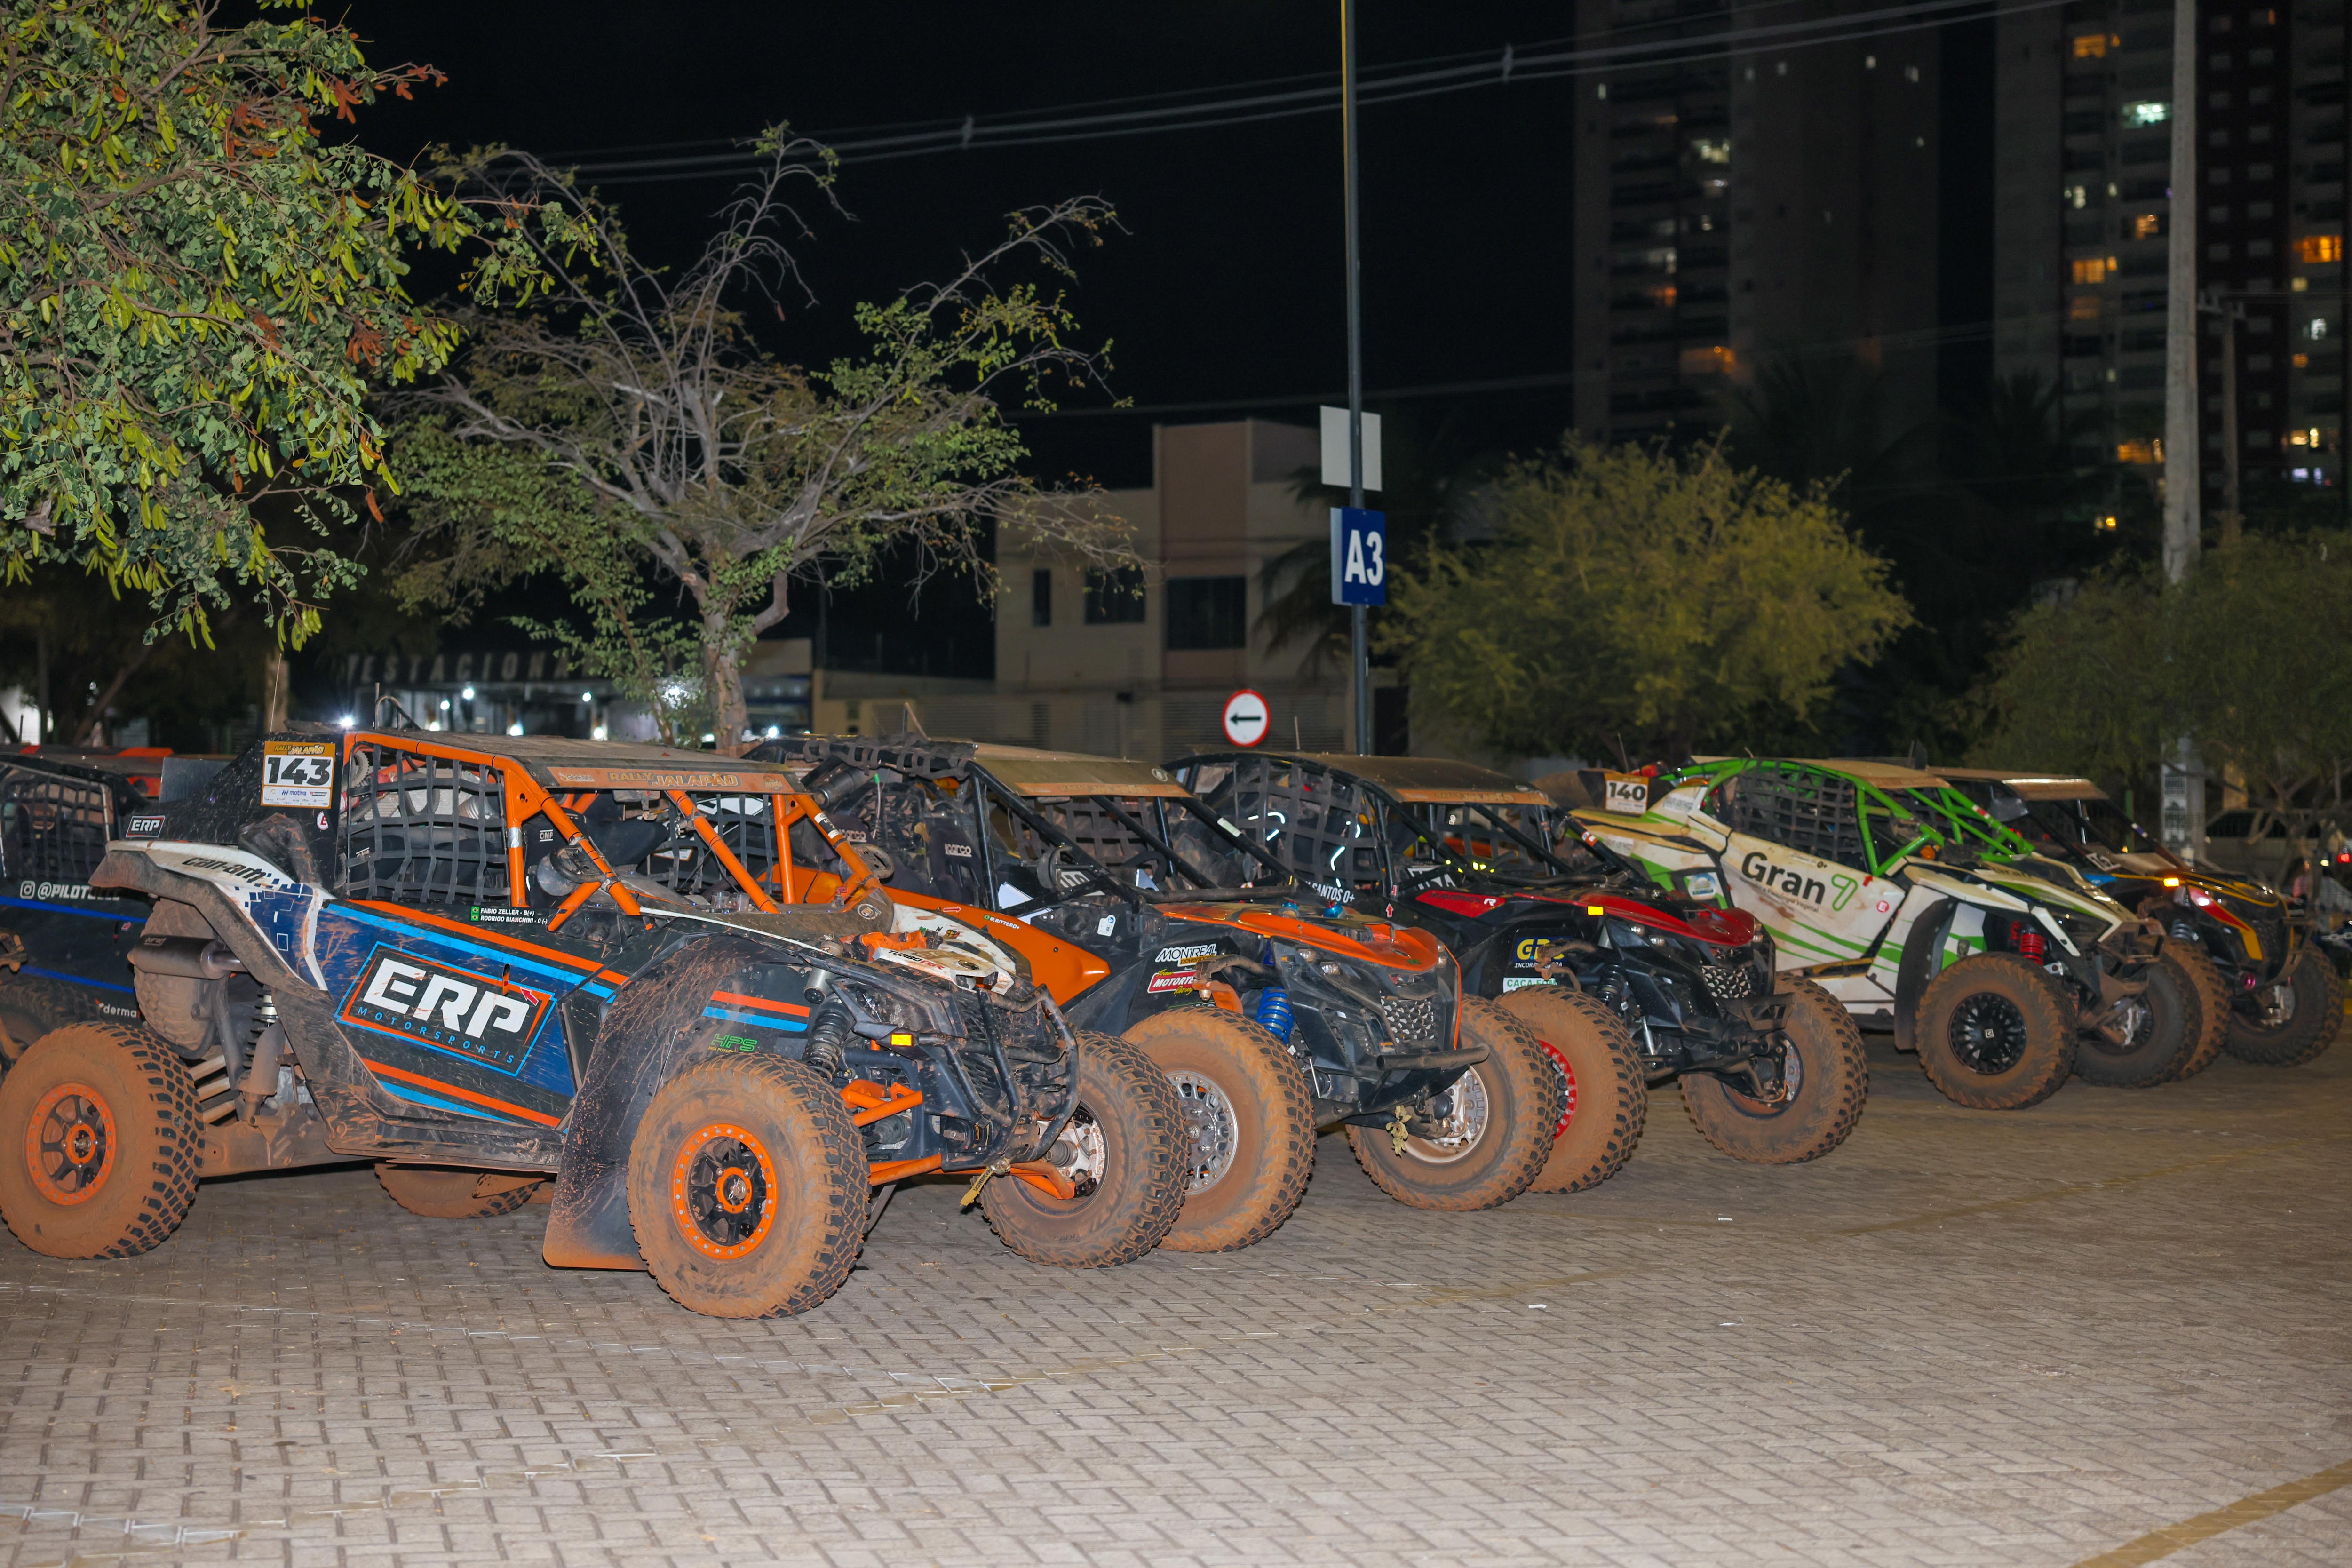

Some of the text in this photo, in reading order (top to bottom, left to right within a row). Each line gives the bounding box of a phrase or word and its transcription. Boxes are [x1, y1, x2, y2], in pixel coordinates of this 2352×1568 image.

[1344, 529, 1383, 586] A3
[287, 745, 324, 755] JALAPÃO
[268, 757, 331, 786] 143
[609, 772, 739, 787] RALLY JALAPÃO
[1609, 782, 1646, 801] 140
[131, 820, 160, 832] ERP
[182, 858, 267, 883] can-am
[1741, 852, 1826, 905] Gran
[1156, 944, 1216, 961] MONTREAL
[1157, 969, 1174, 977] Team
[363, 958, 530, 1039] ERP
[1174, 986, 1193, 996] Racing
[358, 1006, 515, 1064] MOTORSPORTS
[711, 1033, 758, 1052] HPS
